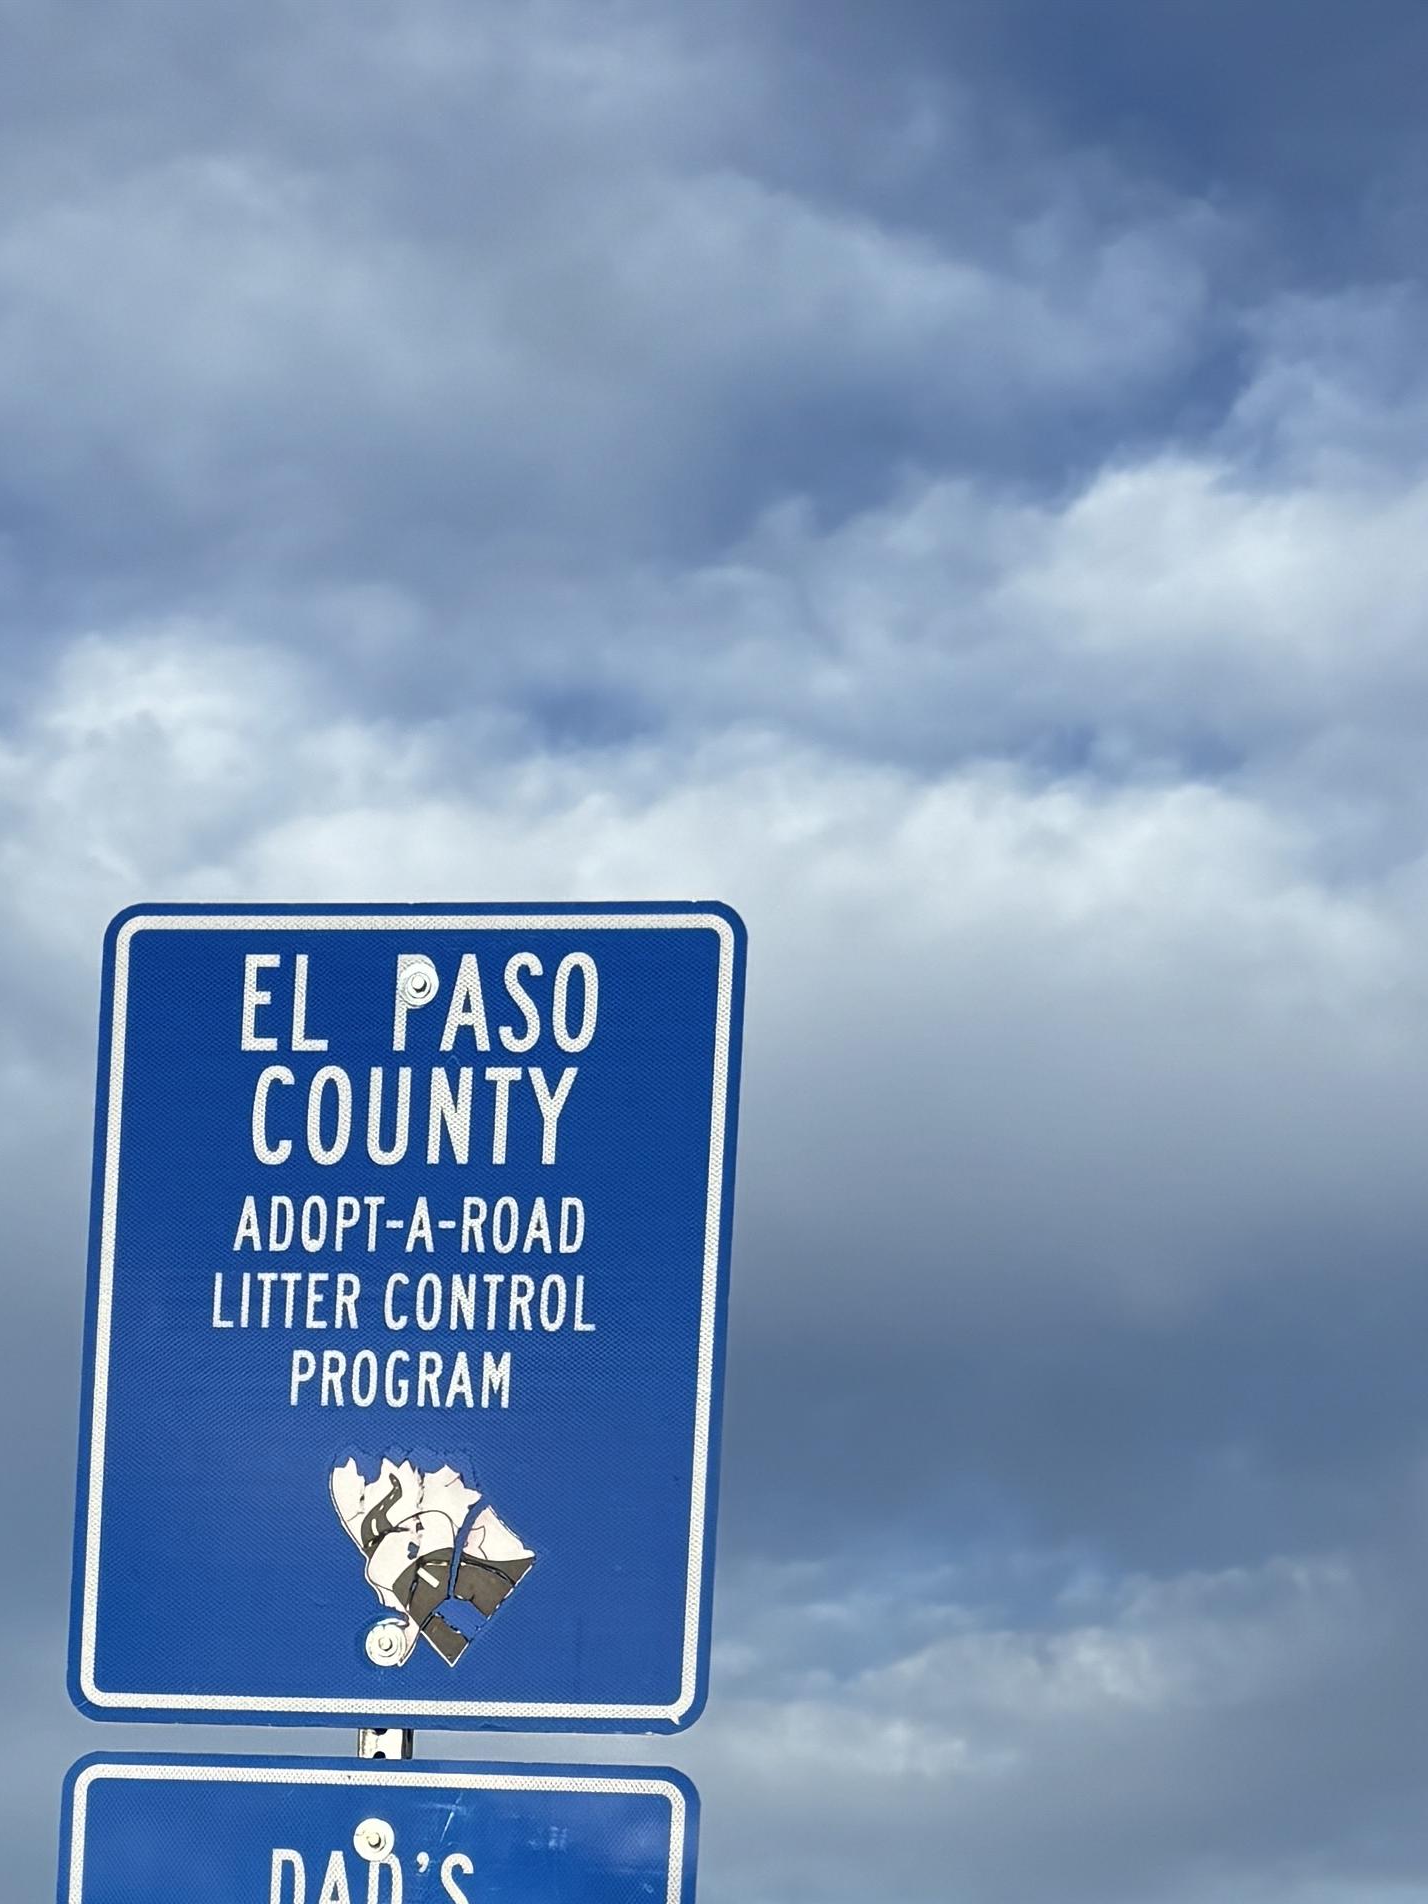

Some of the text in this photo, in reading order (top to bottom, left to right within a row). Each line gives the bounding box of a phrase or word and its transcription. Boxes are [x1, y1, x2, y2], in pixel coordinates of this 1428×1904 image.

[240, 951, 599, 1053] EL PASO
[251, 1065, 578, 1166] COUNTY
[233, 1195, 586, 1254] ADOPT-A-ROAD
[212, 1272, 597, 1332] LITTER CONTROL
[290, 1349, 512, 1409] PROGRAM
